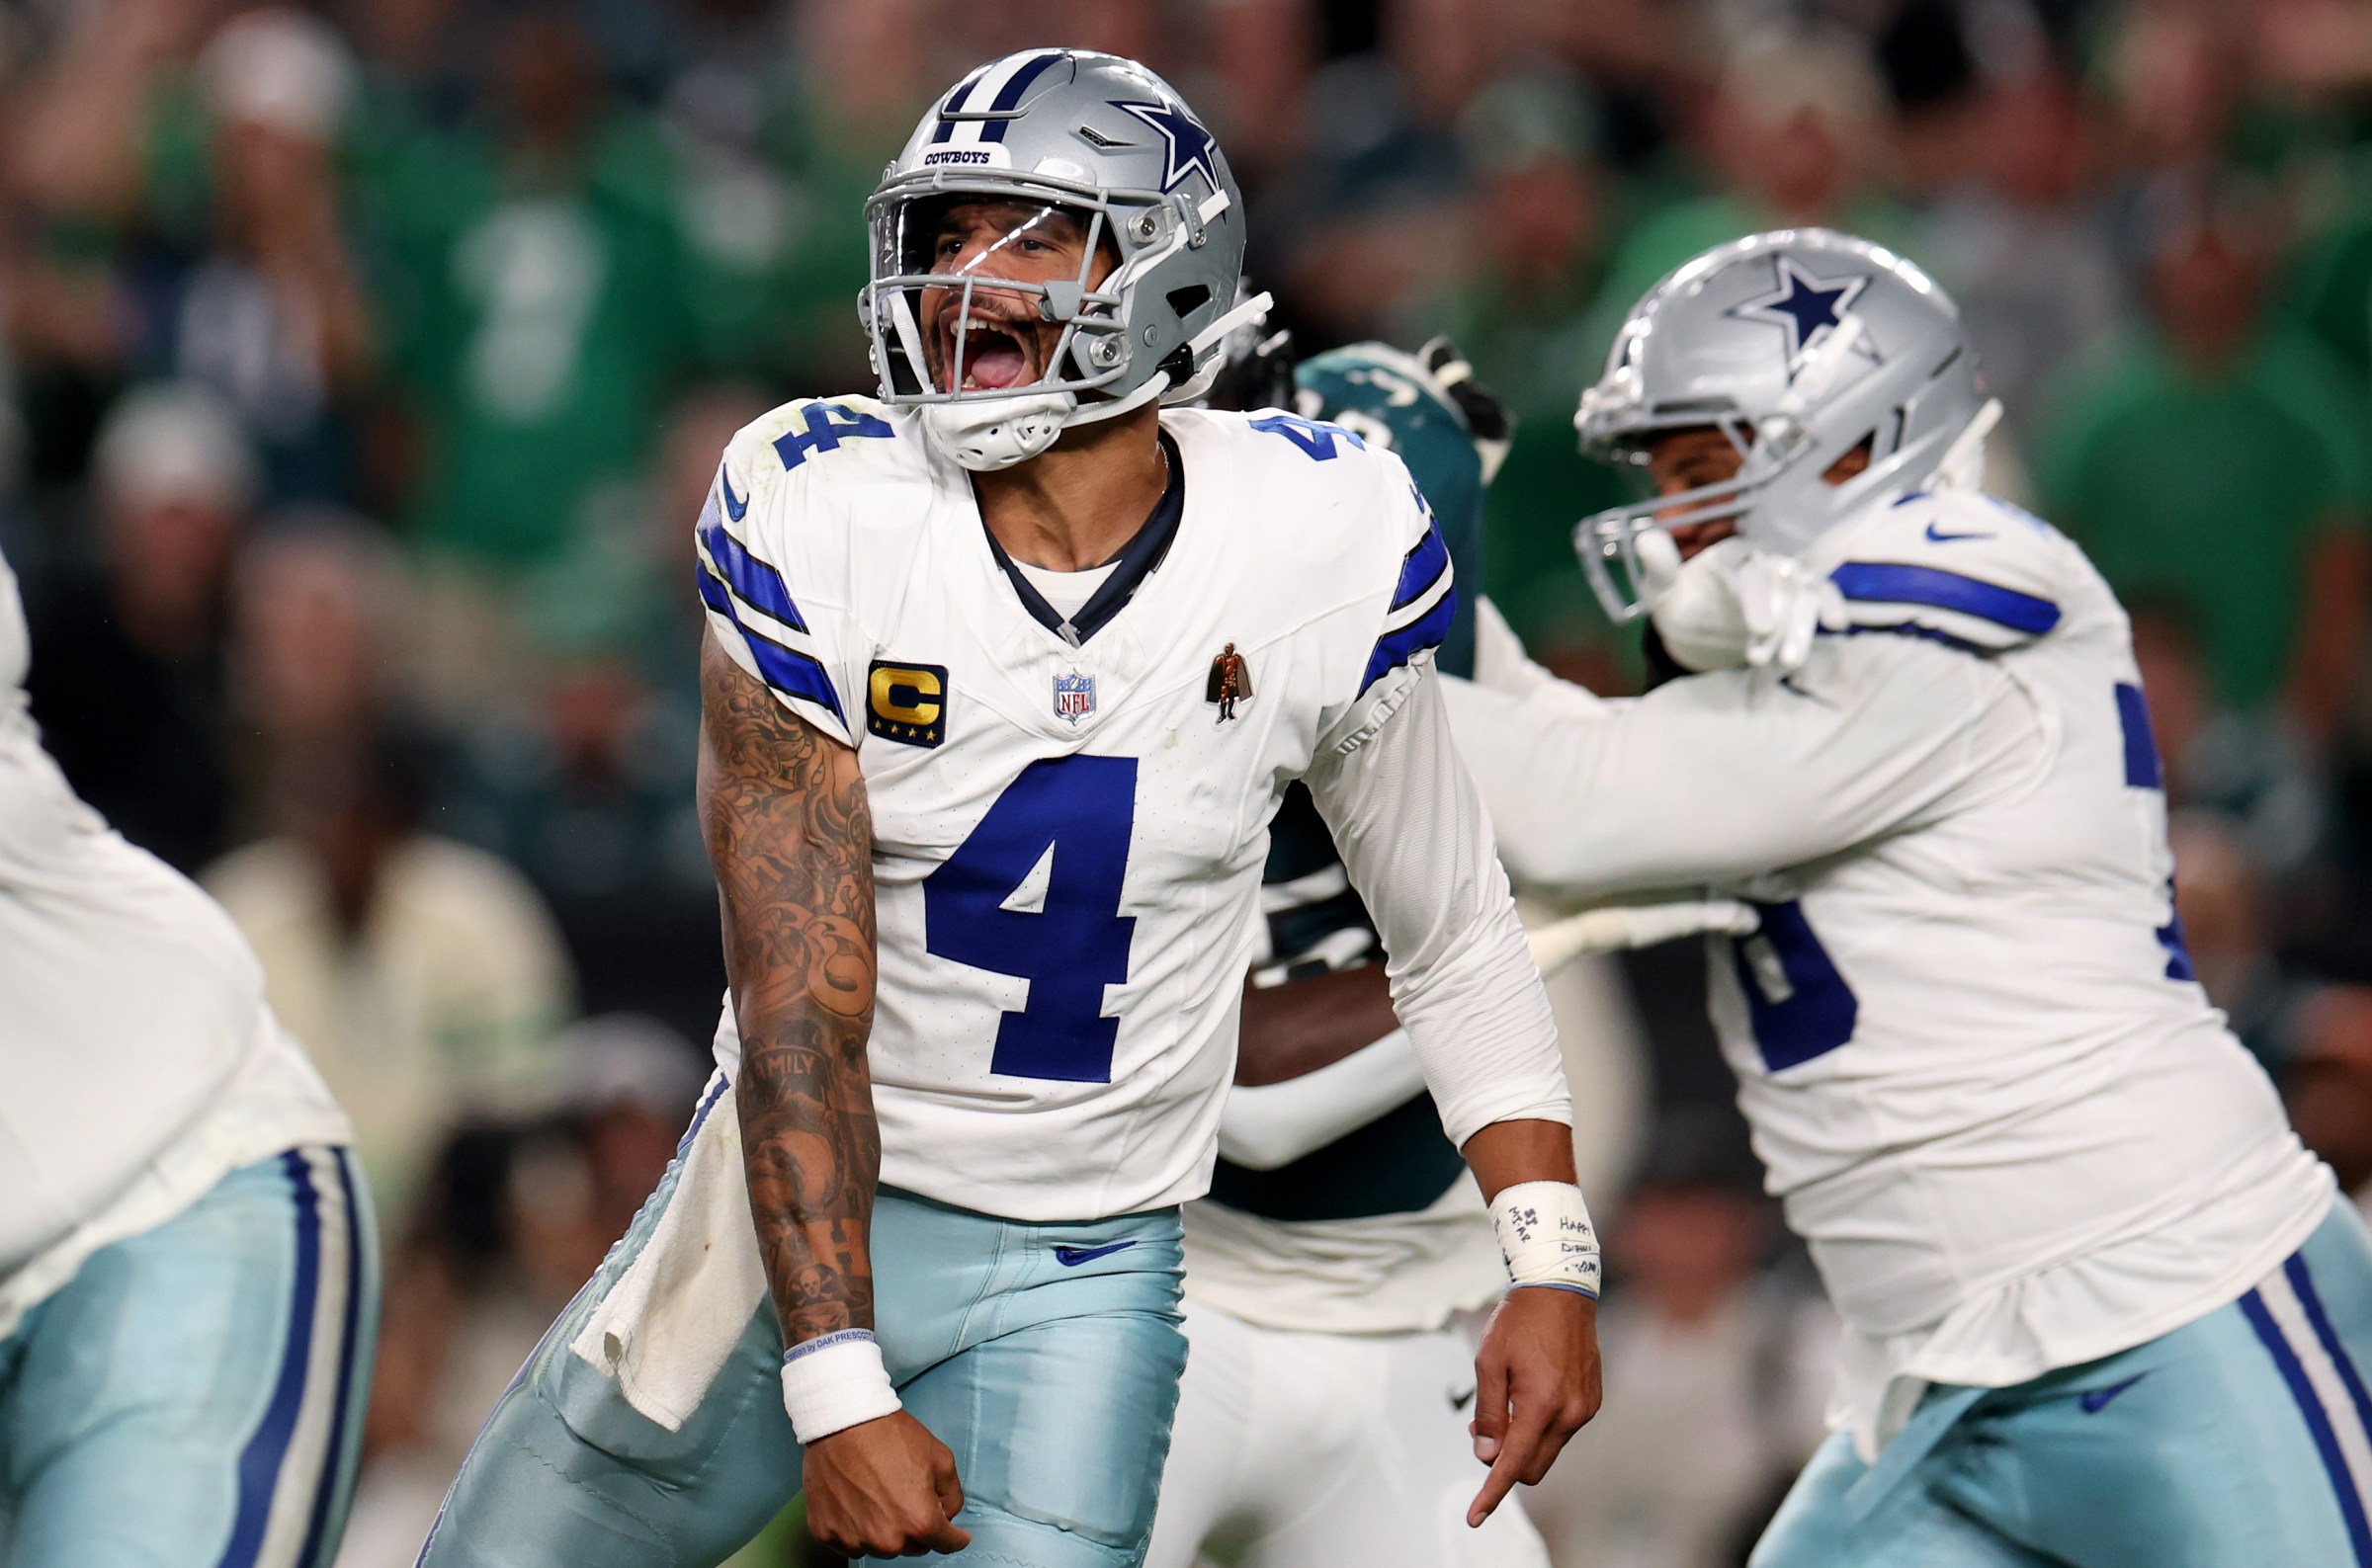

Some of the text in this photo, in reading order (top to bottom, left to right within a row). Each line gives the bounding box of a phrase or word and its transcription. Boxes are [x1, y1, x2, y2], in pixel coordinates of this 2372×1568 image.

[924, 151, 990, 165] COWBOYS
[772, 402, 895, 472] 4
[871, 668, 941, 725] C
[1060, 694, 1090, 714] NFL
[922, 753, 1139, 1083] 4
[816, 1337, 835, 1348] DAK
